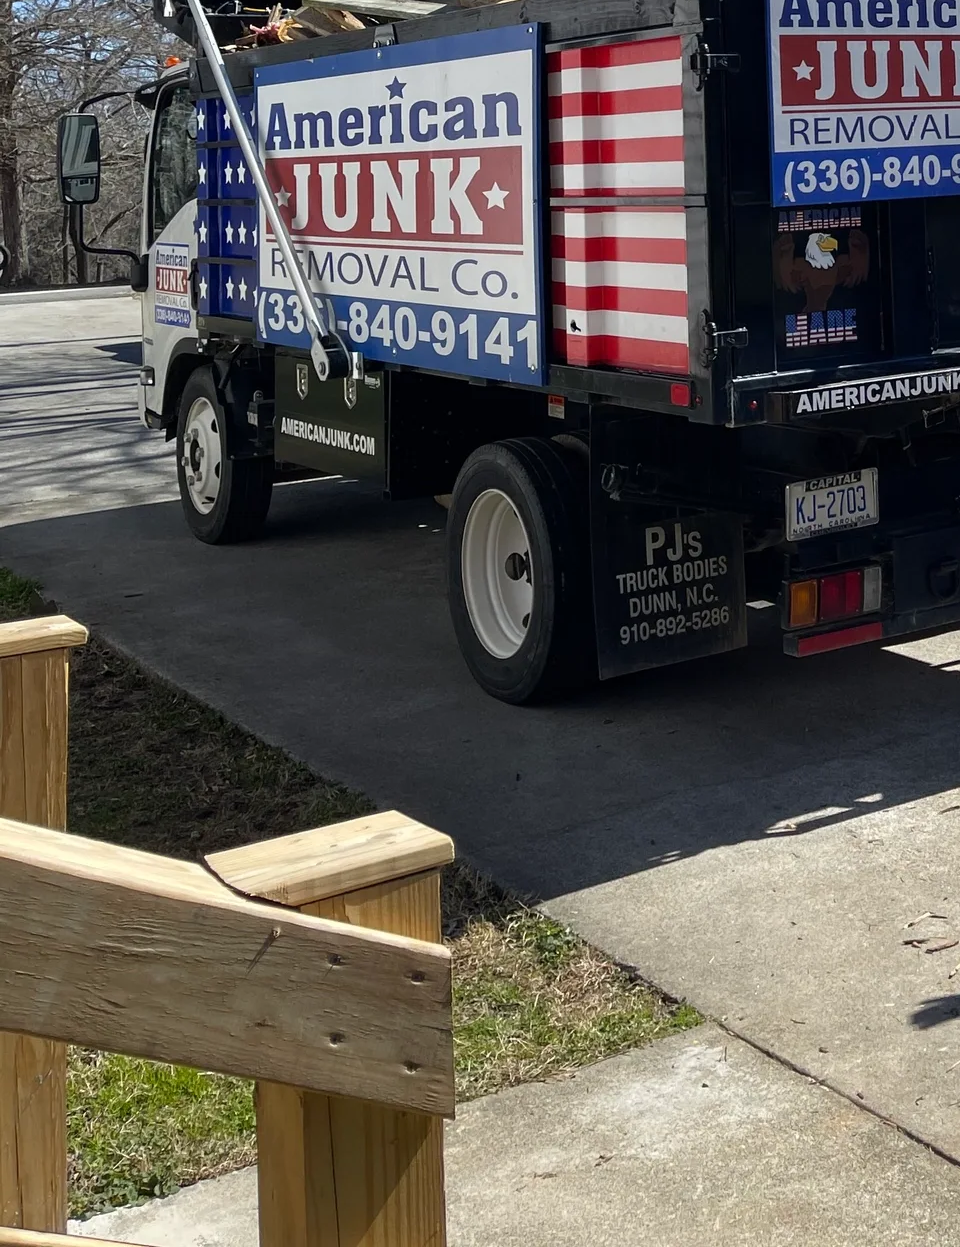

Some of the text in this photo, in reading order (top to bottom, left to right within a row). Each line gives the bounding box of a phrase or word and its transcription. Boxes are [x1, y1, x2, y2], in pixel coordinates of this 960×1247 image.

[265, 91, 522, 150] American
[789, 113, 960, 145] REMOVAL
[292, 156, 484, 235] JUNK
[778, 207, 862, 232] AMERICAN
[156, 250, 188, 267] American
[271, 247, 519, 299] RMOVAL Co.
[159, 268, 184, 292] JUNK
[258, 290, 538, 369] (33)-840-9141
[785, 308, 858, 347] MADE
[280, 416, 375, 456] AMERICANJUNK.COM
[809, 472, 858, 491] CAPITAL
[793, 523, 823, 535] NORTH
[828, 513, 871, 527] CAROLINA
[796, 485, 867, 525] KJ-2703
[615, 555, 728, 595] TRUCK BODIES
[629, 583, 719, 618] DUNN, N.C.
[619, 605, 730, 645] 910-892-5286
